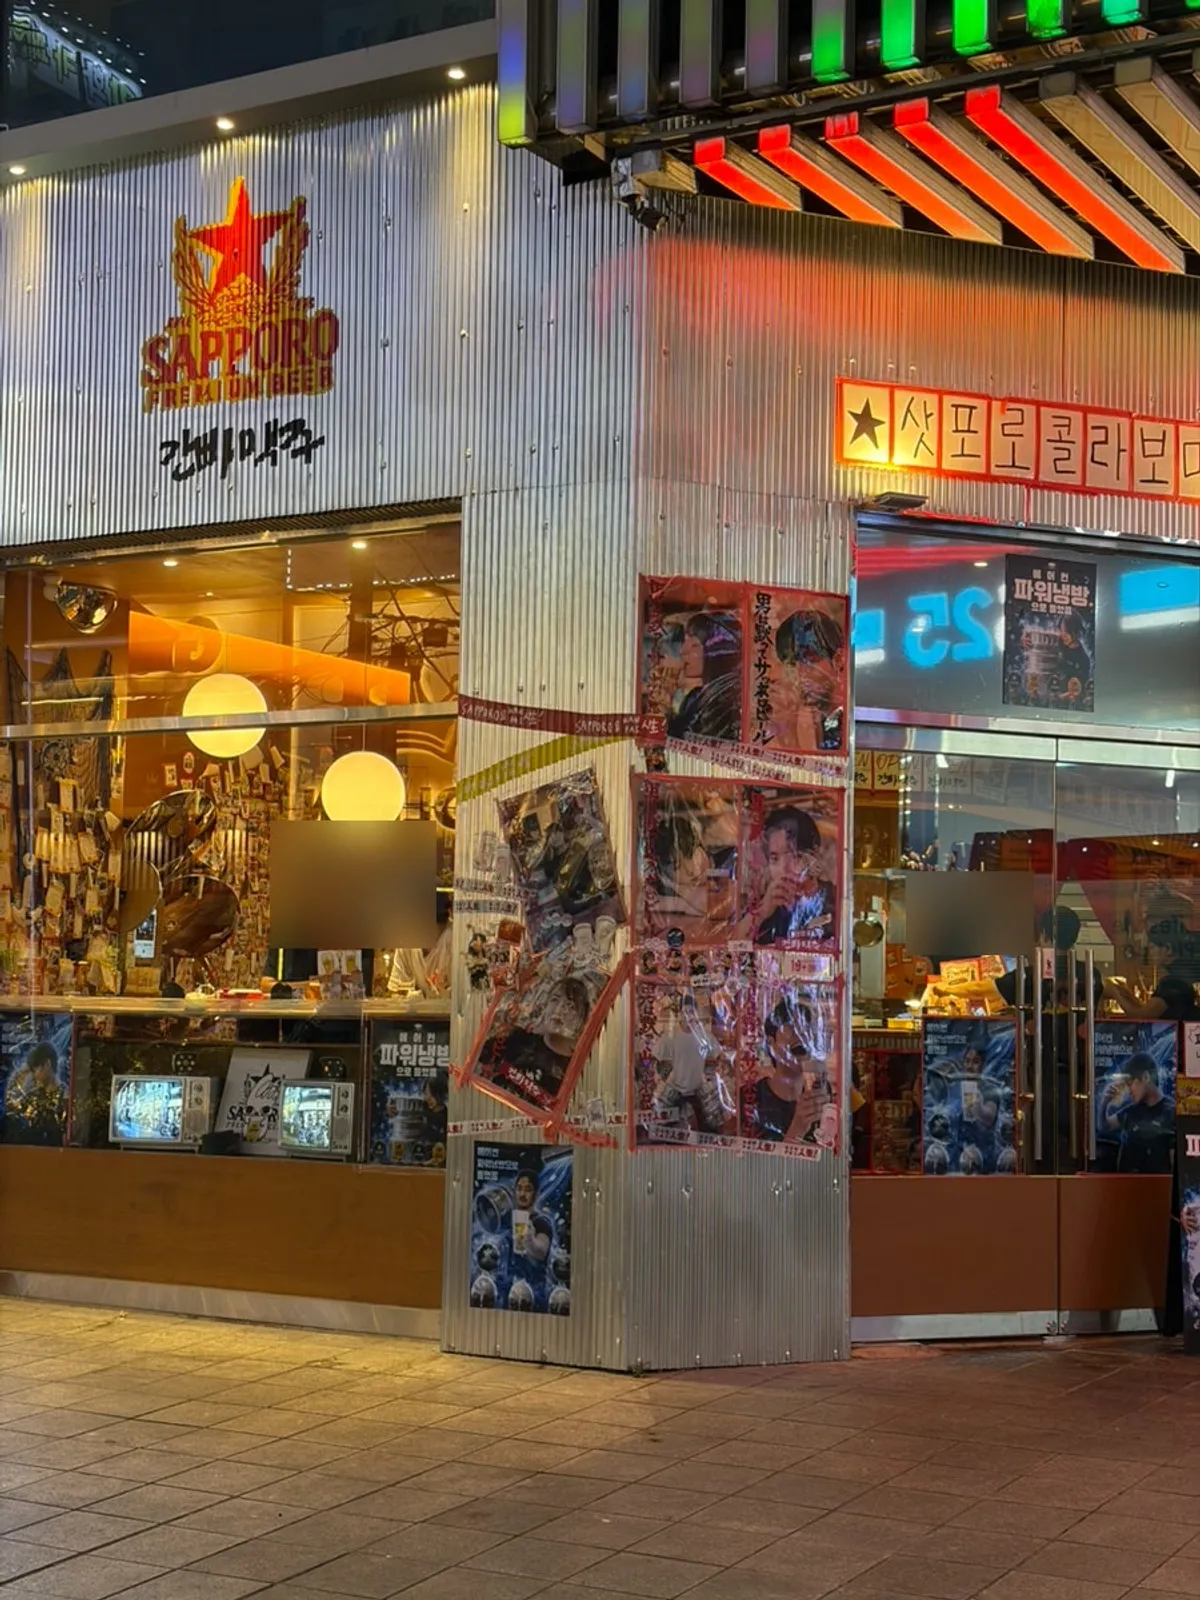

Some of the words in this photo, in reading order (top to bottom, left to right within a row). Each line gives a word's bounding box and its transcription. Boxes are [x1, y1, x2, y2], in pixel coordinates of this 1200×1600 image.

[143, 309, 339, 384] SAPPORO
[146, 374, 260, 410] PREMIUM
[271, 363, 333, 397] BEER
[901, 396, 1200, 486] 삿포로콜라보
